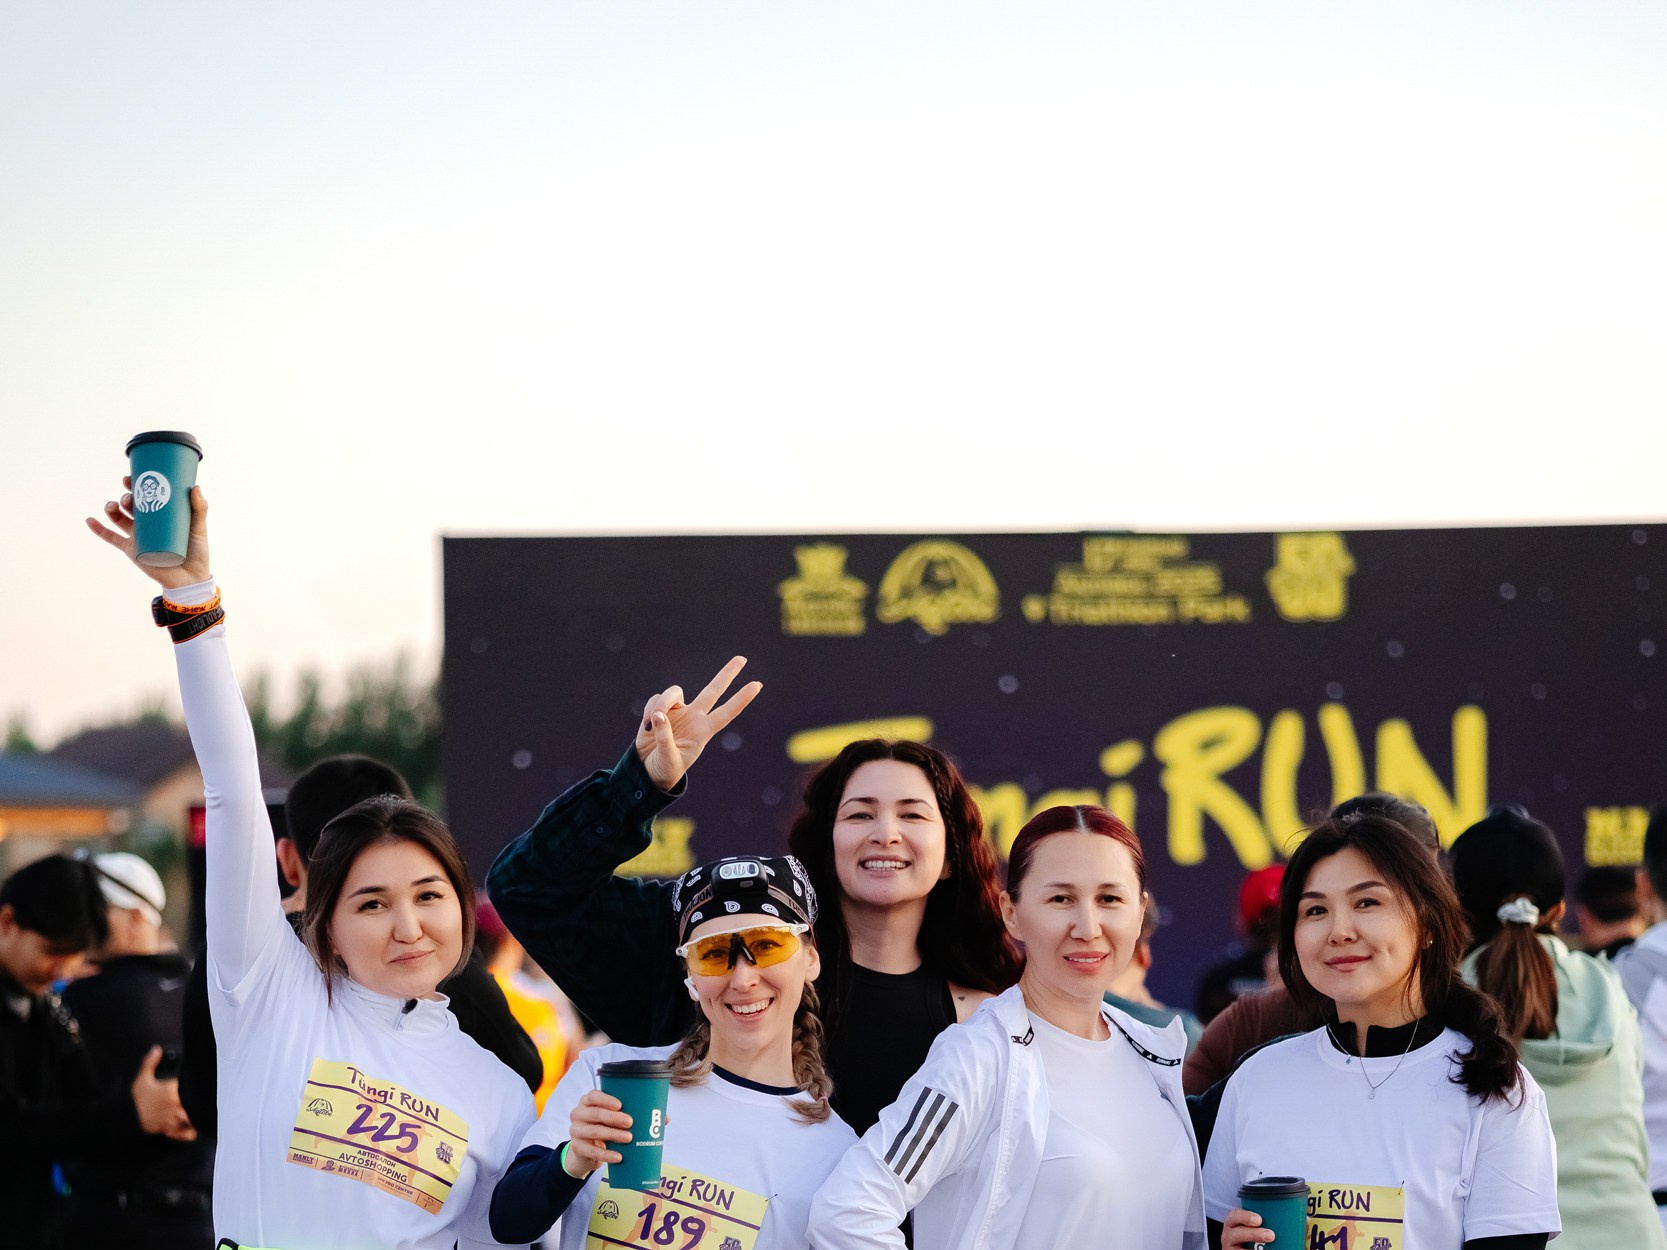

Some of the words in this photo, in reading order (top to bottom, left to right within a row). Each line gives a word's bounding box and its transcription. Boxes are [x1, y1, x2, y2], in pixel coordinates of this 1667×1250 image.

[1154, 702, 1489, 871] RUN
[400, 1092, 440, 1121] RUN
[346, 1103, 421, 1153] 225
[338, 1152, 408, 1183] AVTOSHOPPING
[357, 1150, 397, 1168] АВТОСАЛОН
[659, 1176, 687, 1200] ngi
[690, 1179, 735, 1210] RUN
[1328, 1189, 1371, 1212] RUN
